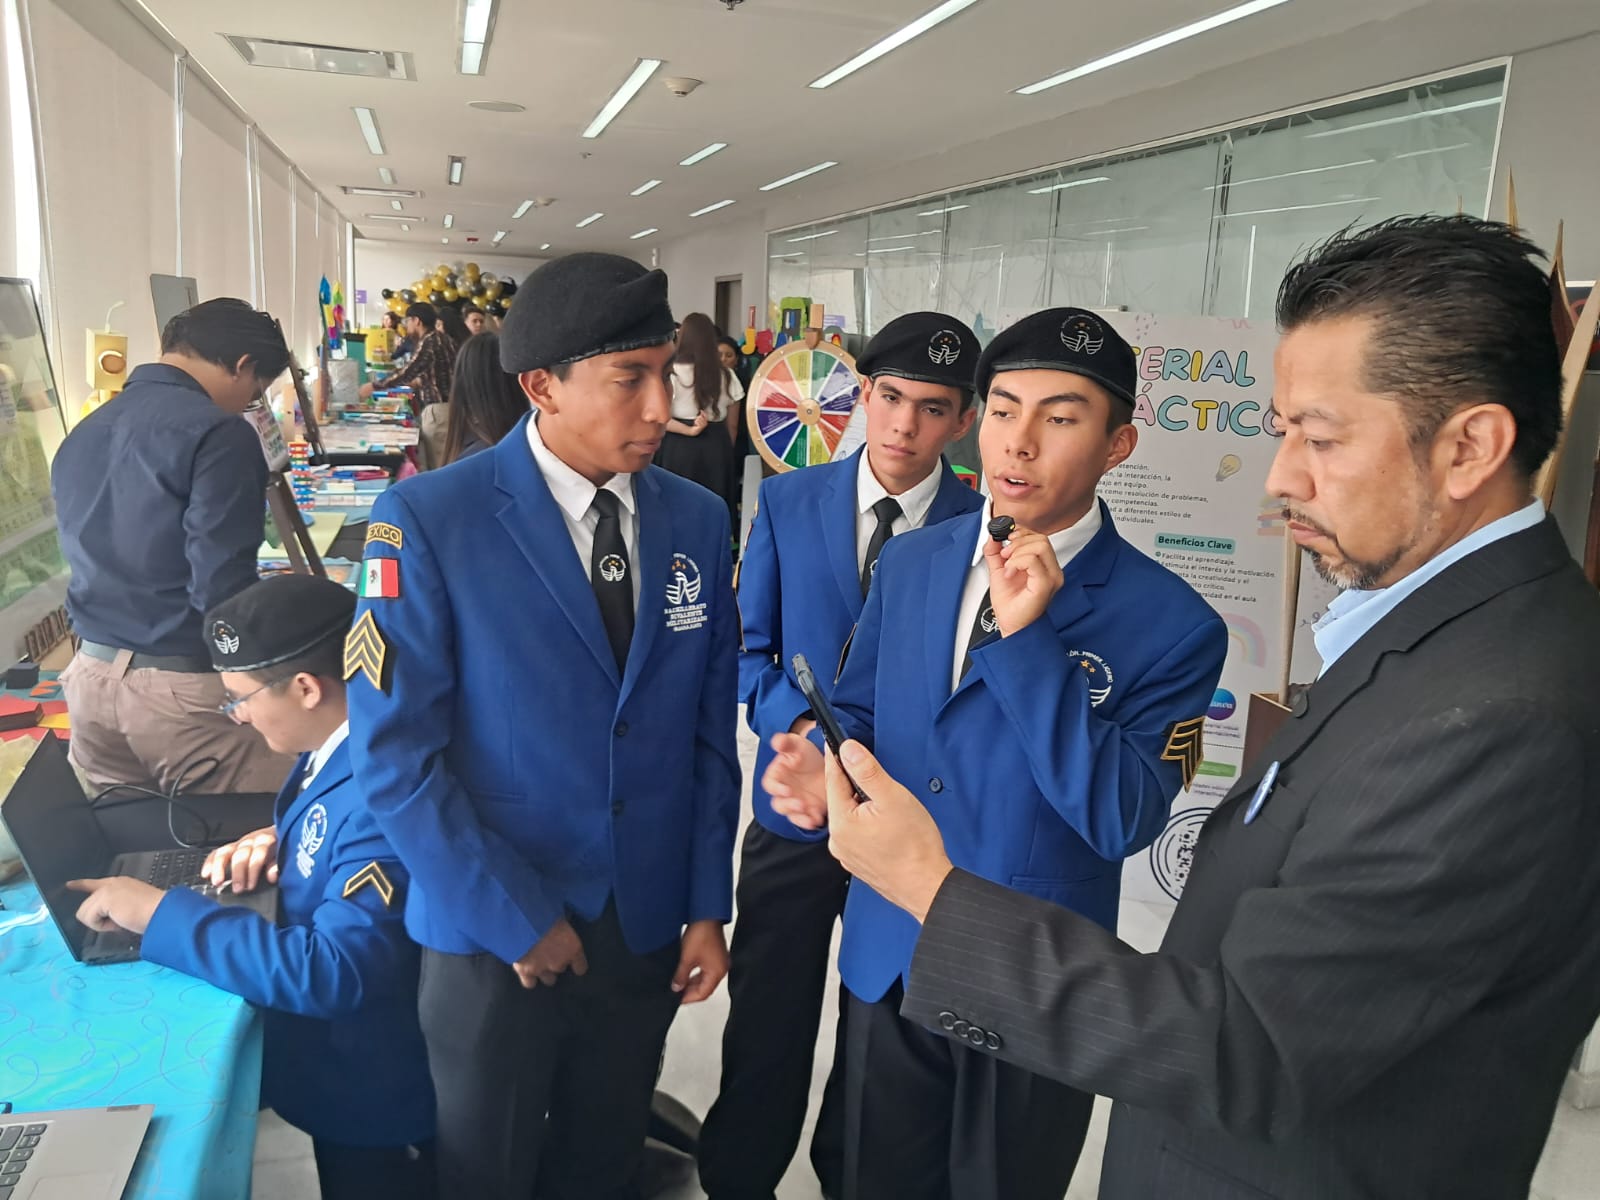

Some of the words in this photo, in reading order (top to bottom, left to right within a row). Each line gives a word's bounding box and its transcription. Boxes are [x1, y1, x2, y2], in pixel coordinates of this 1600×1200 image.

[1131, 346, 1256, 387] ERIAL
[1132, 382, 1286, 437] ÁCTICO
[368, 526, 399, 541] EXICO
[1158, 535, 1205, 547] Beneficios
[1207, 540, 1232, 550] Clave
